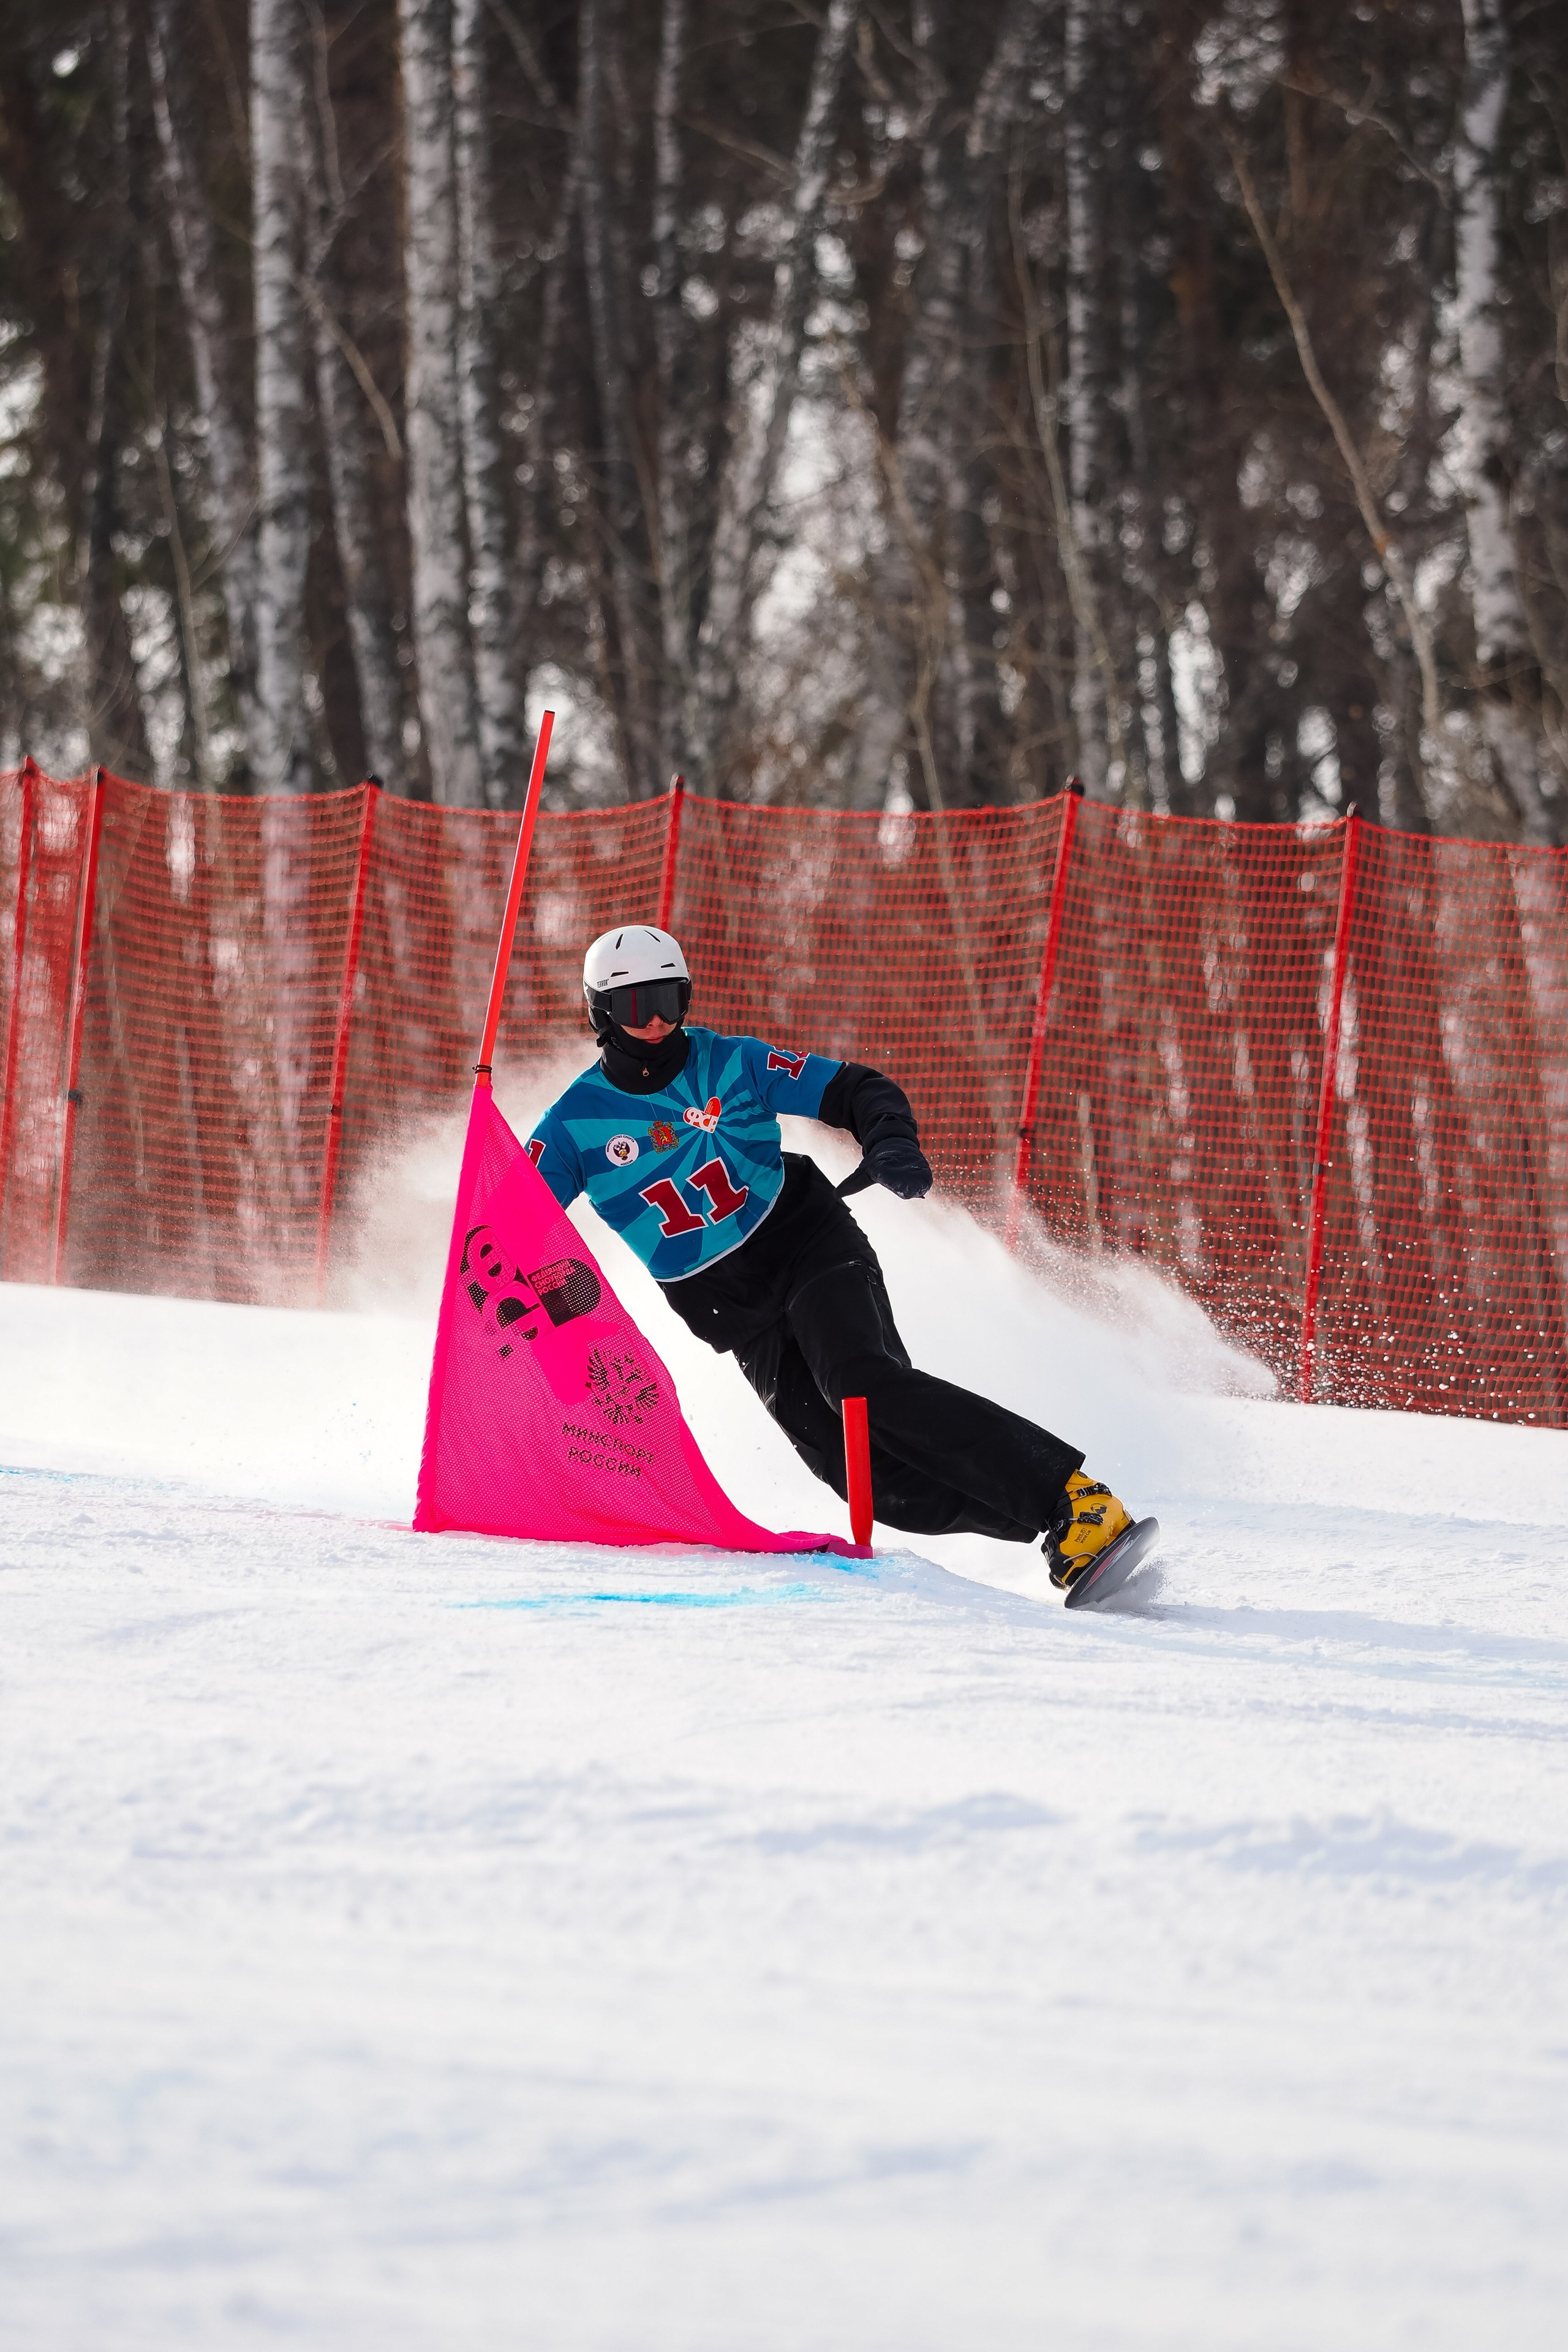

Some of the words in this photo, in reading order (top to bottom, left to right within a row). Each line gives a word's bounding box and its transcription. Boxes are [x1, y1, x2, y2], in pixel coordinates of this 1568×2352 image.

[623, 1135, 635, 1144] СПОРТА
[638, 1156, 749, 1238] 11
[531, 1260, 571, 1281] ФЕДЕРАЦИЯ
[535, 1267, 576, 1289] СНОУБОРДА
[538, 1278, 568, 1296] РОССИИ
[562, 1422, 655, 1464] МИНСПОРТ
[568, 1446, 641, 1479] РОССИИ
